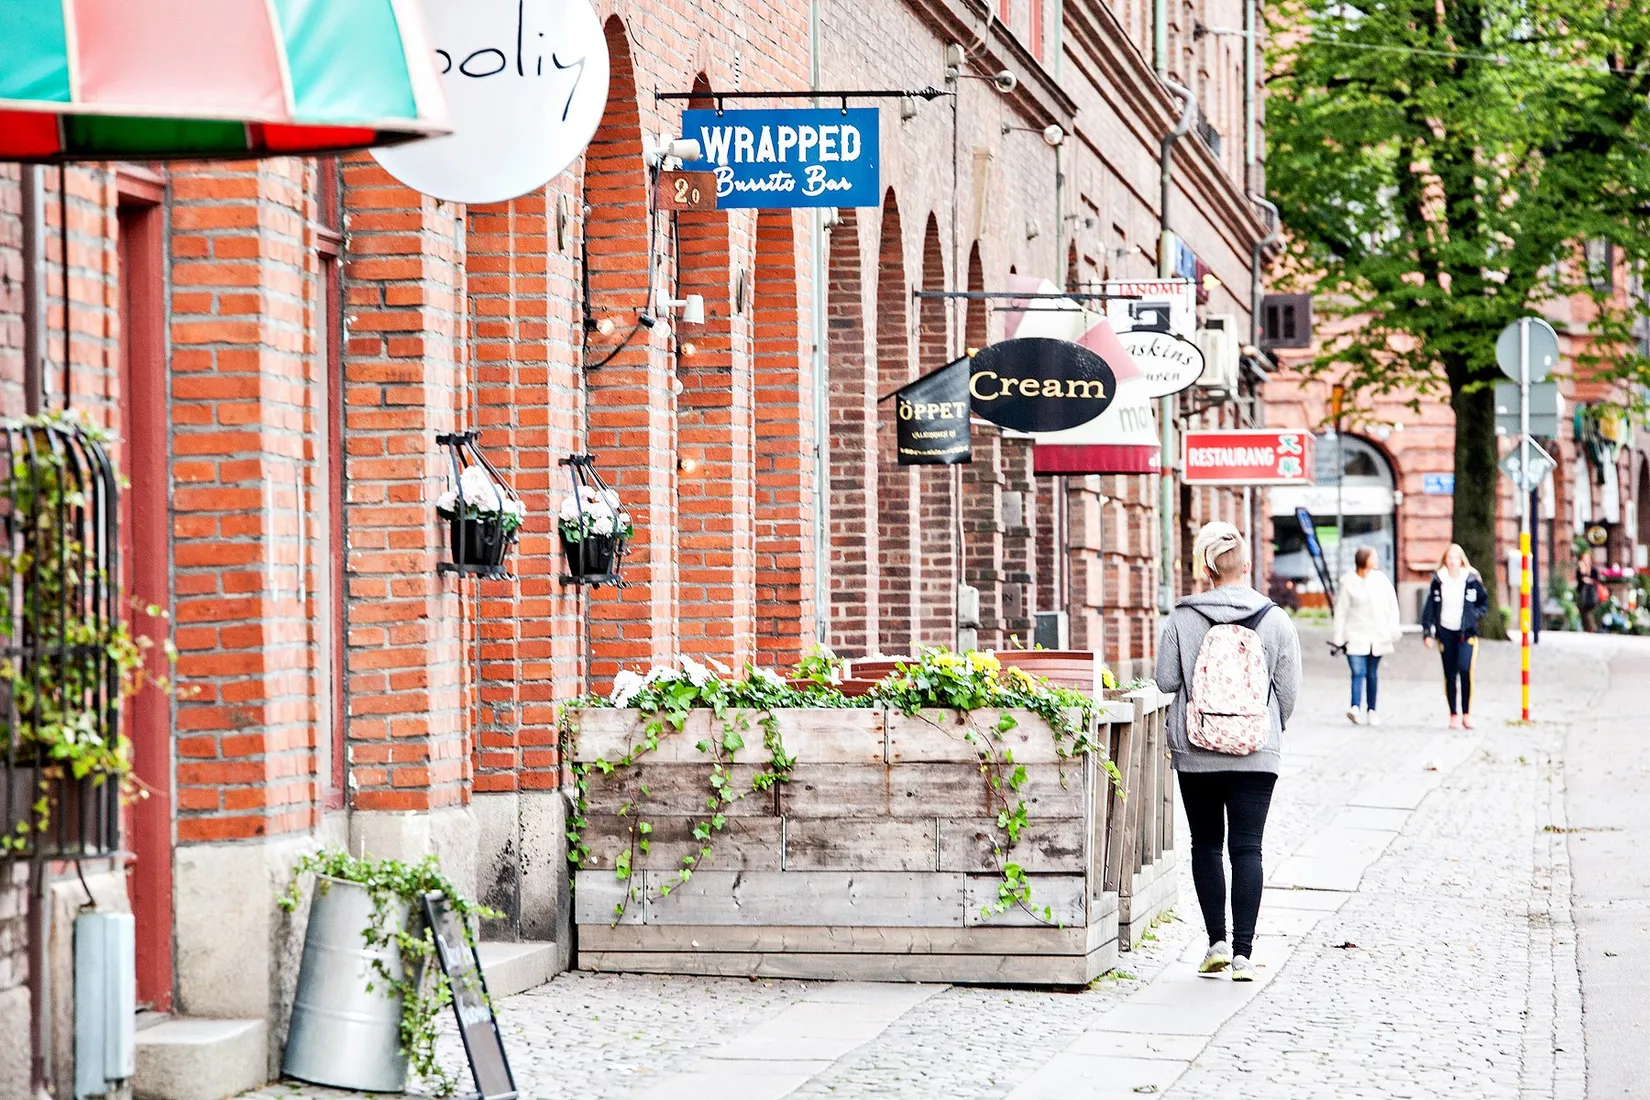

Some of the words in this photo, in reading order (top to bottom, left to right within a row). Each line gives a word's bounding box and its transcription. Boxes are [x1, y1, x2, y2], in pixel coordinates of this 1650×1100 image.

[700, 124, 862, 165] WRAPPED
[713, 166, 796, 197] Burrito
[801, 165, 852, 196] Bar
[968, 370, 1107, 401] Cream
[899, 400, 967, 420] ÖPPET
[1188, 446, 1275, 468] RESTAURANG
